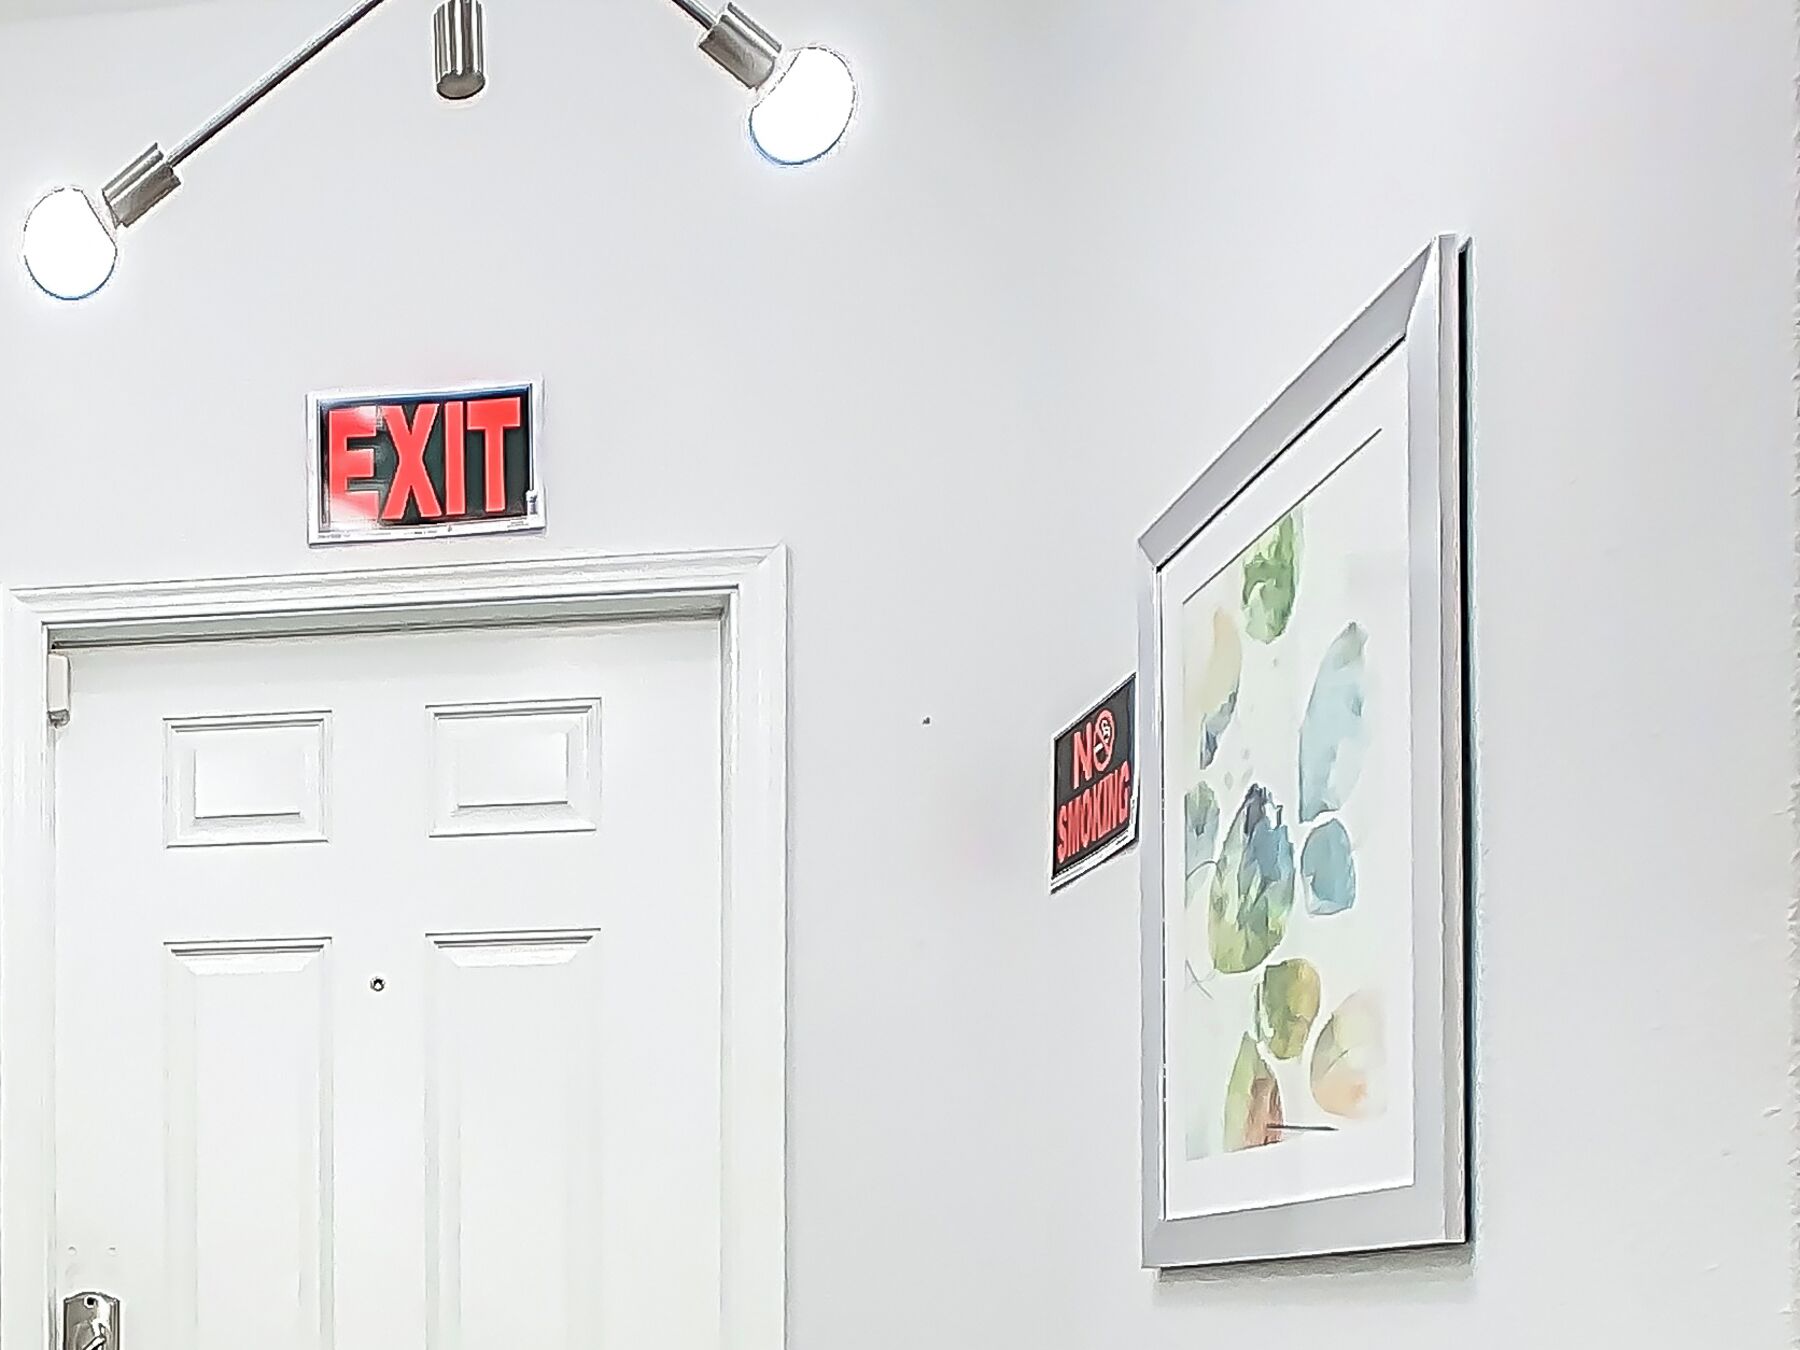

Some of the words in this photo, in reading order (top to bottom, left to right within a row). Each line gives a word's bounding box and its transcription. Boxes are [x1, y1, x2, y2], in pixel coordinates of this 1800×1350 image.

[328, 396, 521, 521] EXIT
[1072, 708, 1115, 789] NO
[1057, 760, 1130, 864] SMOKING
